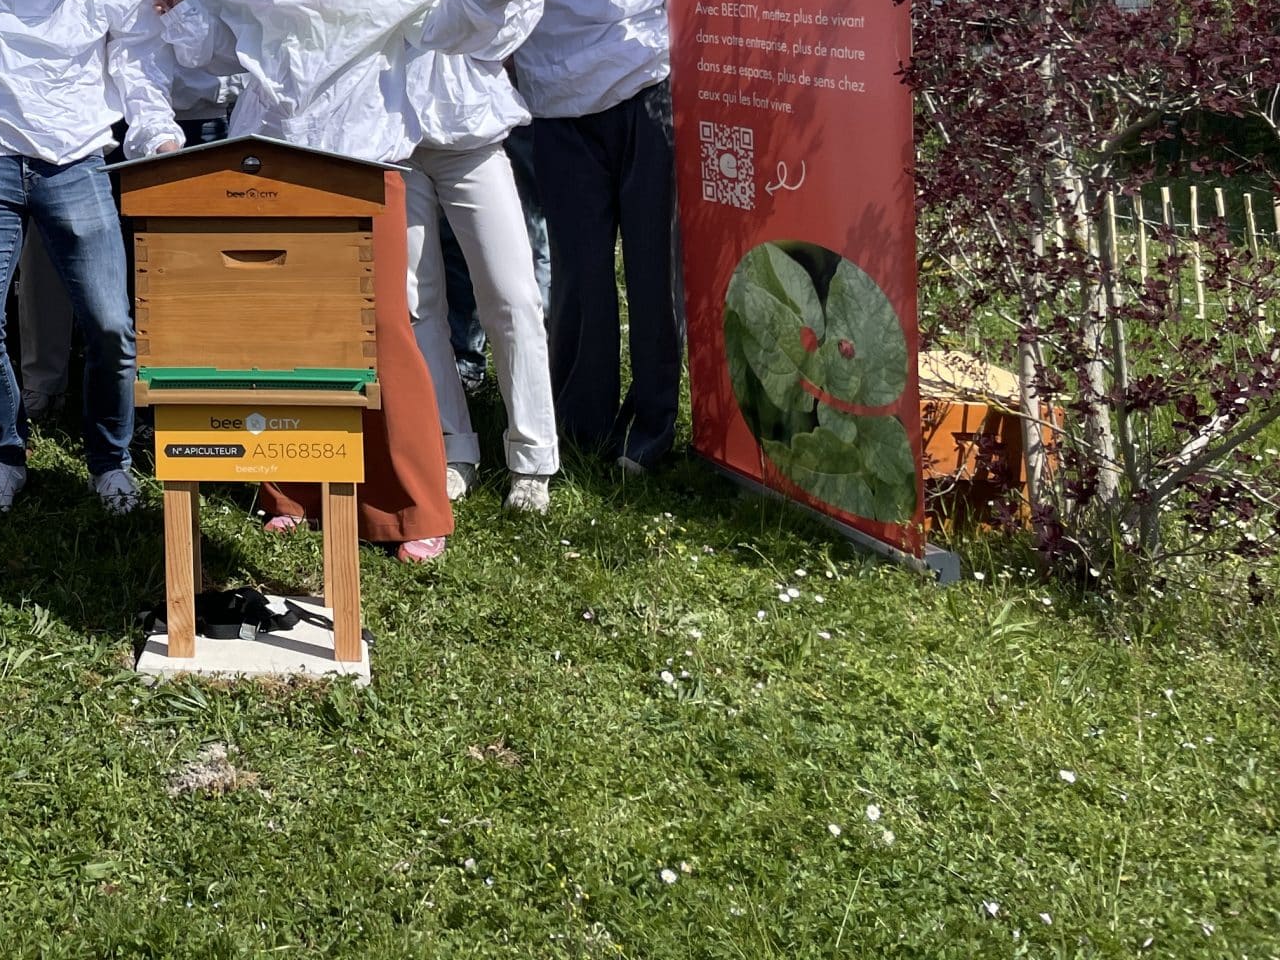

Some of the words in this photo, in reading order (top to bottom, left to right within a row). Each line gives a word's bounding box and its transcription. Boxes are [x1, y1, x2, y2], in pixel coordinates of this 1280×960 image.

[695, 2, 719, 17] Avec
[721, 3, 760, 22] BEECITY,
[762, 10, 791, 23] mettez
[793, 8, 813, 27] plus
[815, 10, 829, 25] de
[831, 15, 865, 28] vivant
[696, 29, 720, 45] dans
[721, 35, 744, 47] votre
[746, 39, 790, 54] entreprise,
[792, 39, 812, 56] plus
[814, 42, 828, 57] de
[830, 47, 865, 61] nature
[697, 58, 720, 73] dans
[722, 63, 737, 75] ses
[738, 65, 775, 82] espaces,
[777, 68, 796, 84] plus
[798, 70, 811, 86] de
[813, 76, 835, 89] sens
[838, 75, 865, 92] chez
[698, 90, 720, 102] ceux
[722, 93, 737, 108] qui
[738, 91, 751, 106] les
[752, 92, 769, 109] font
[771, 100, 794, 114] vivre.
[226, 190, 246, 198] bee
[210, 416, 243, 429] bee
[269, 418, 301, 430] CITY
[184, 447, 238, 455] APICULTEUR
[252, 443, 347, 459] A5168584
[235, 464, 278, 475] beecity.fr
